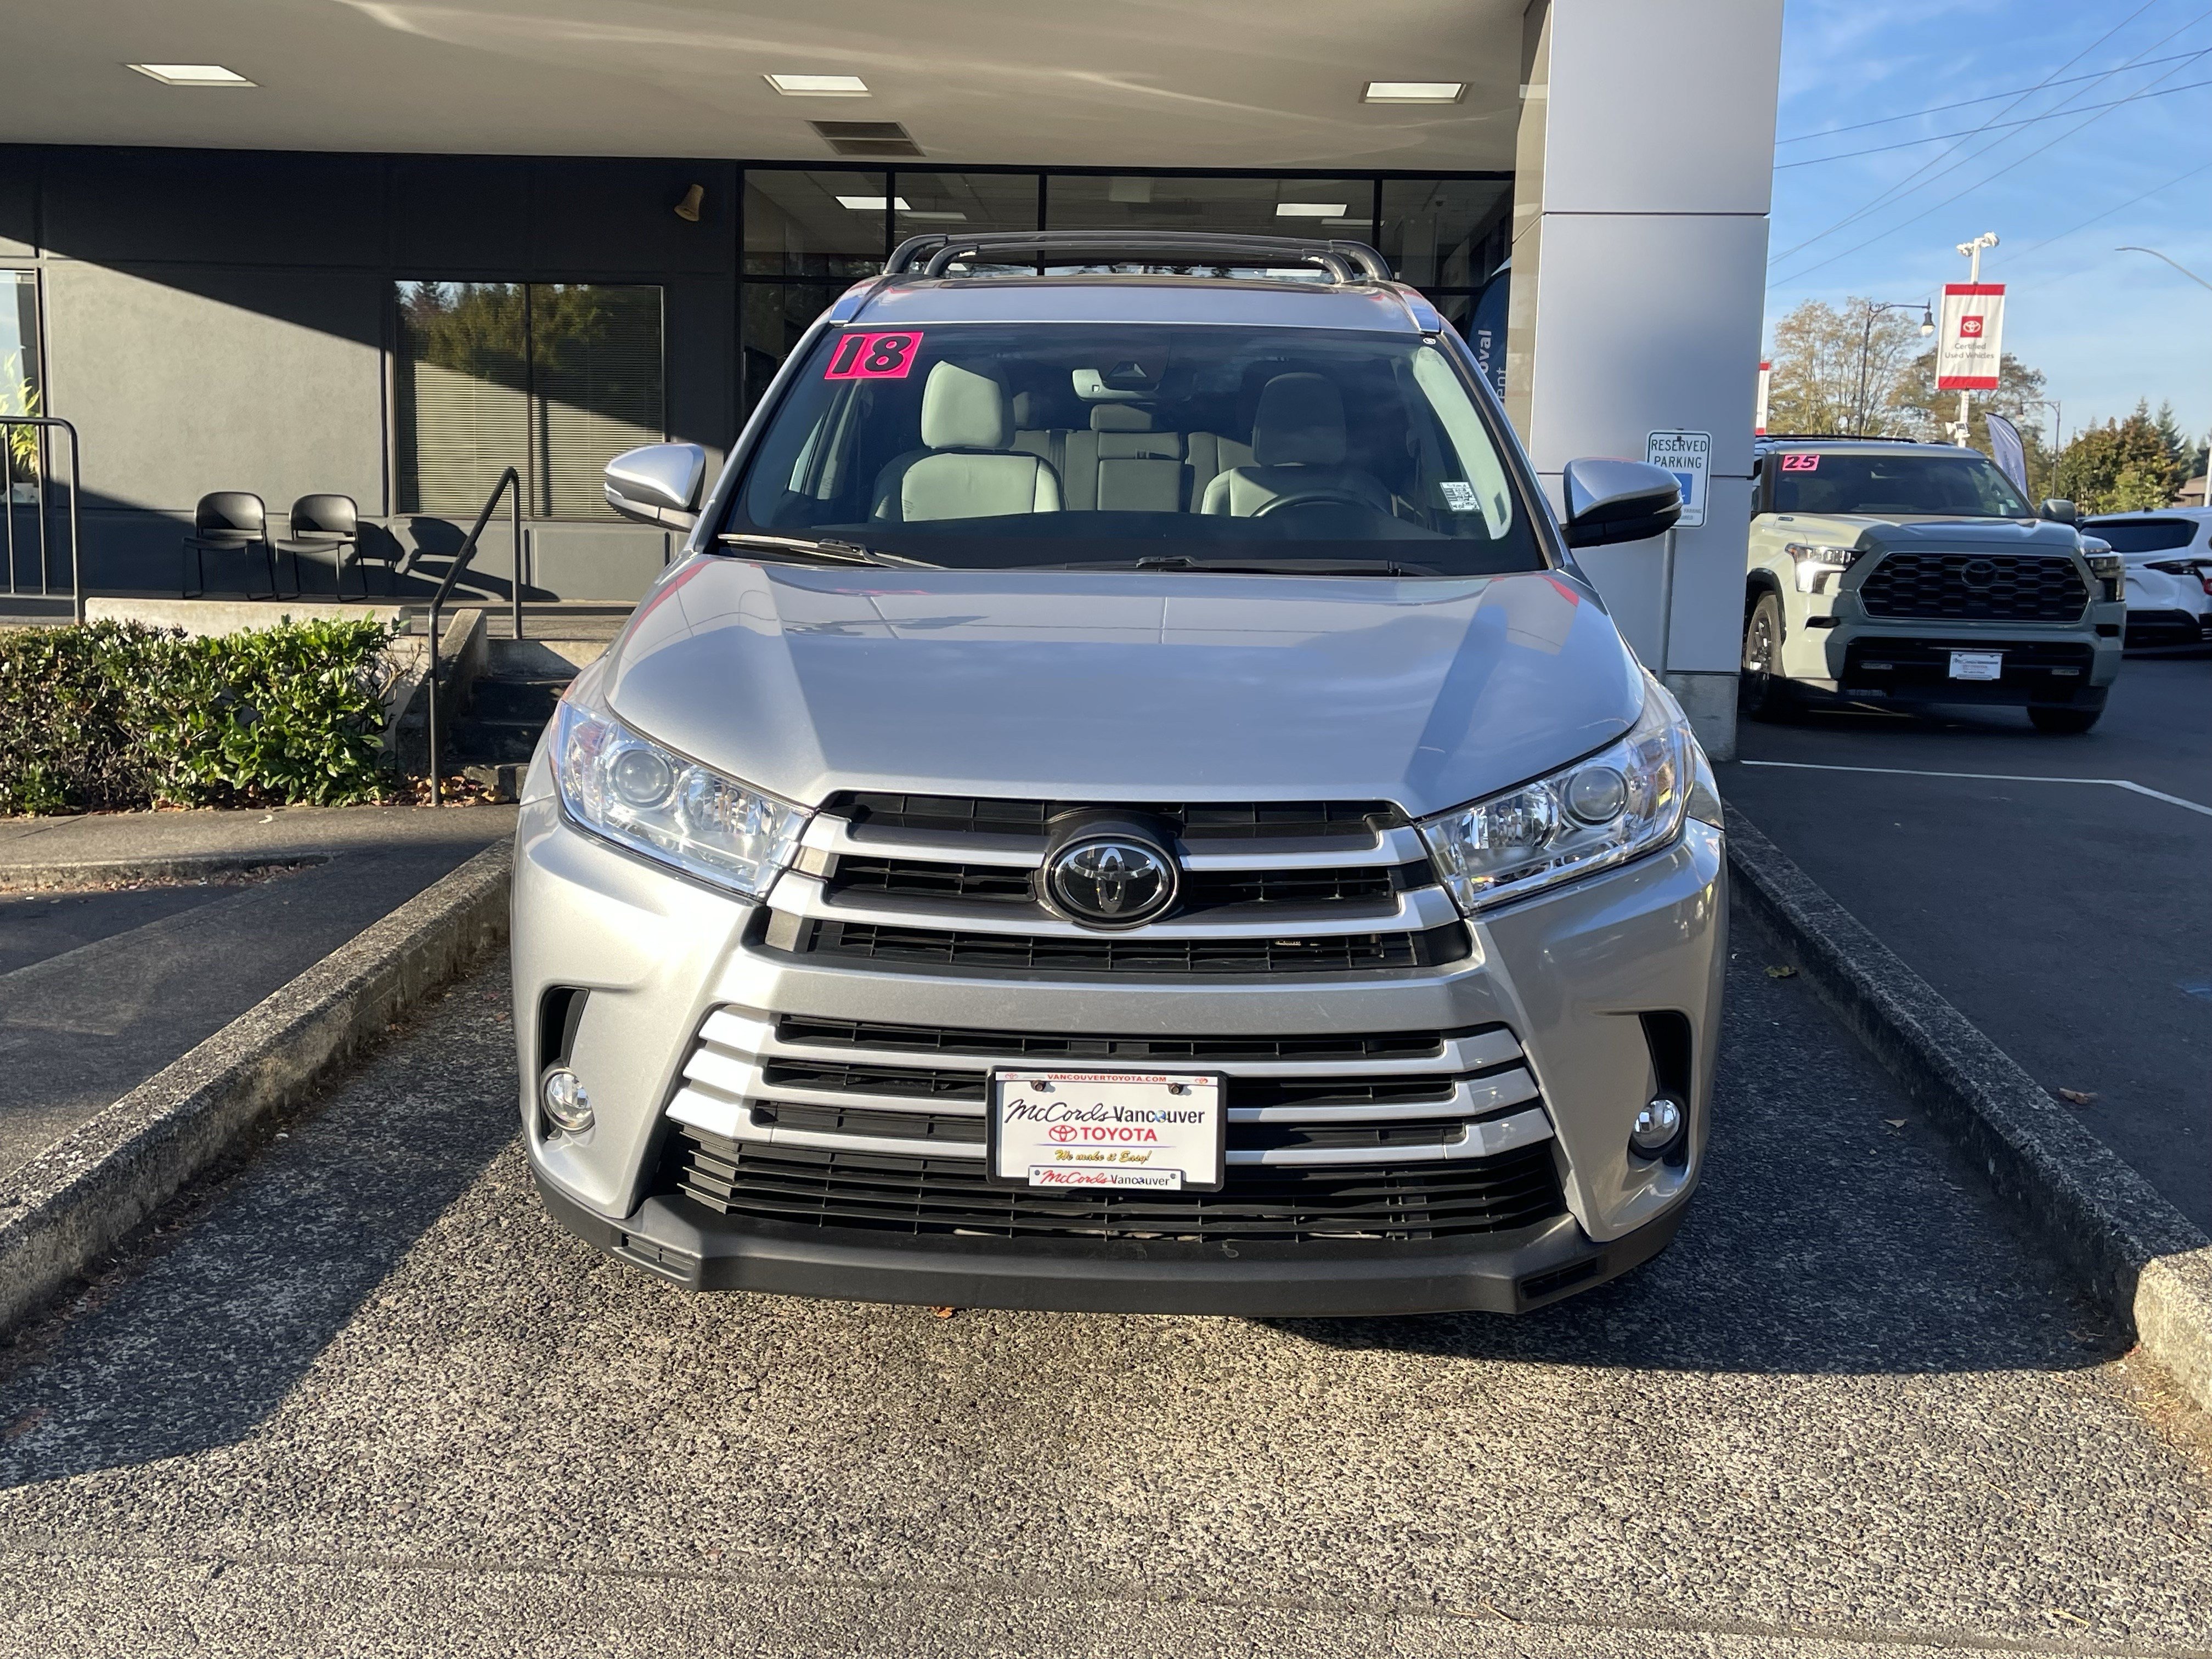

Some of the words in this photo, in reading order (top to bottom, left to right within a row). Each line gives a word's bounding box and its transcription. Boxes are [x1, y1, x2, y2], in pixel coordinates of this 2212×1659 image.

[832, 336, 912, 374] 18
[1651, 439, 1707, 452] RESERVED
[1654, 456, 1702, 469] PARKING
[1785, 456, 1817, 469] 25
[1047, 1074, 1166, 1082] VANCOUVERTOYOTA.COM
[1080, 1126, 1158, 1142] TOYOTA
[1054, 1149, 1074, 1161] We
[1075, 1150, 1104, 1161] make
[1107, 1152, 1117, 1161] it
[1119, 1150, 1153, 1165] Easy!
